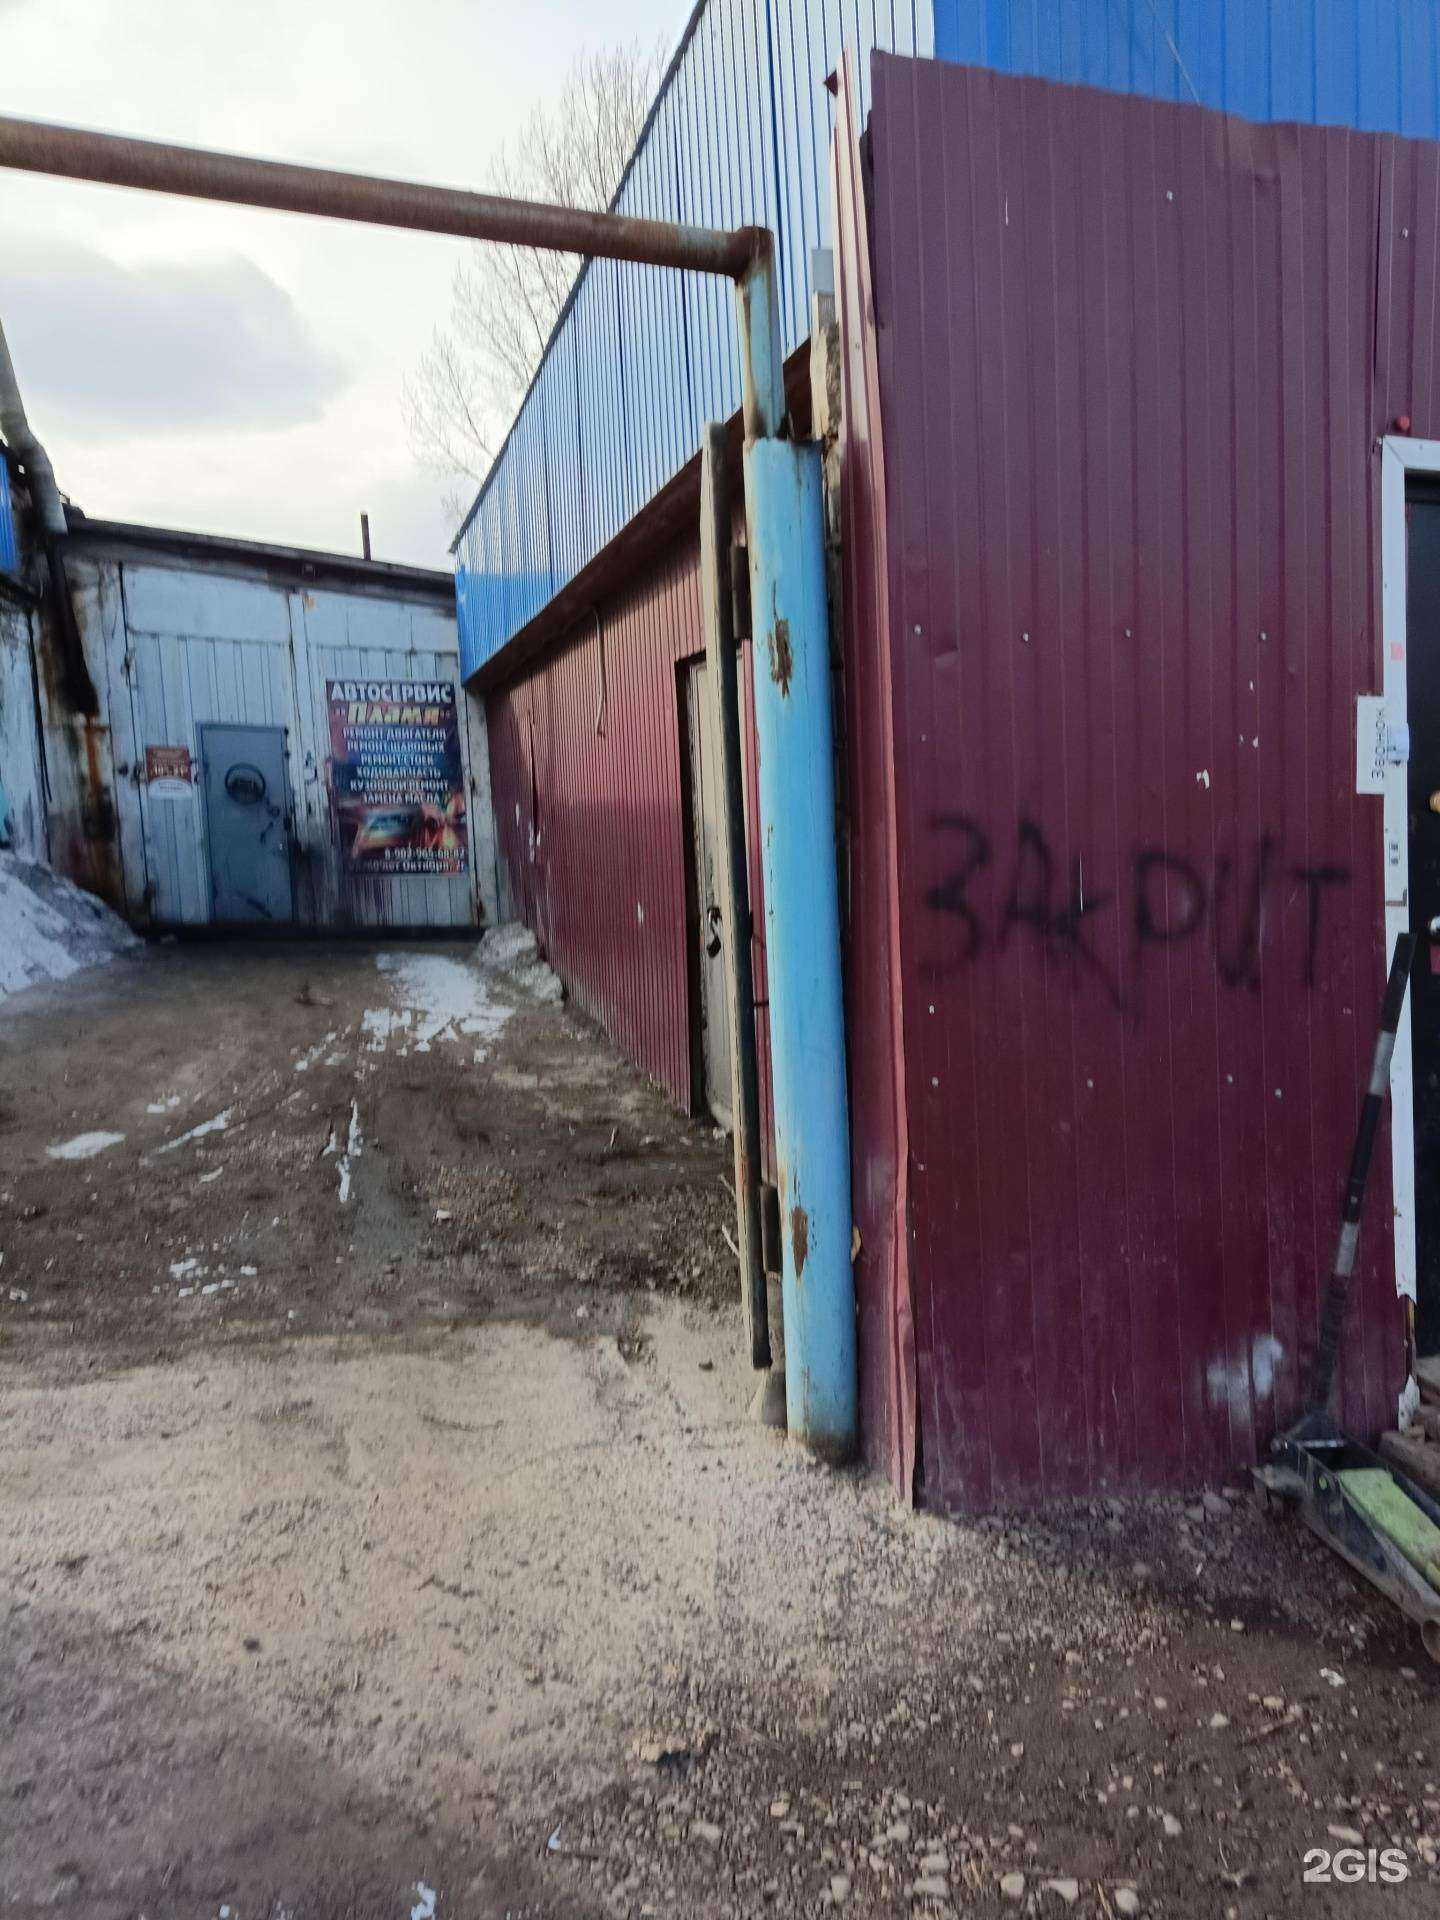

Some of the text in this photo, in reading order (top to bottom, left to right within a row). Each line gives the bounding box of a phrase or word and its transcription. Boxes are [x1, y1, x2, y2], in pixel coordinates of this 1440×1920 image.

[331, 682, 452, 703] АВТОСЕРВИС
[343, 728, 447, 741] РЕМОНТ ДВИГАТЕЛЯ
[347, 741, 445, 753] РЕМОНТ ШАРОВЫХ
[361, 753, 434, 766] РЕМОНТ СТОЕК
[356, 766, 406, 779] ХОДОВАЯ
[350, 779, 449, 792] КУЗОВНОЙ РЕМОНТ
[405, 792, 440, 804] МАСЛА
